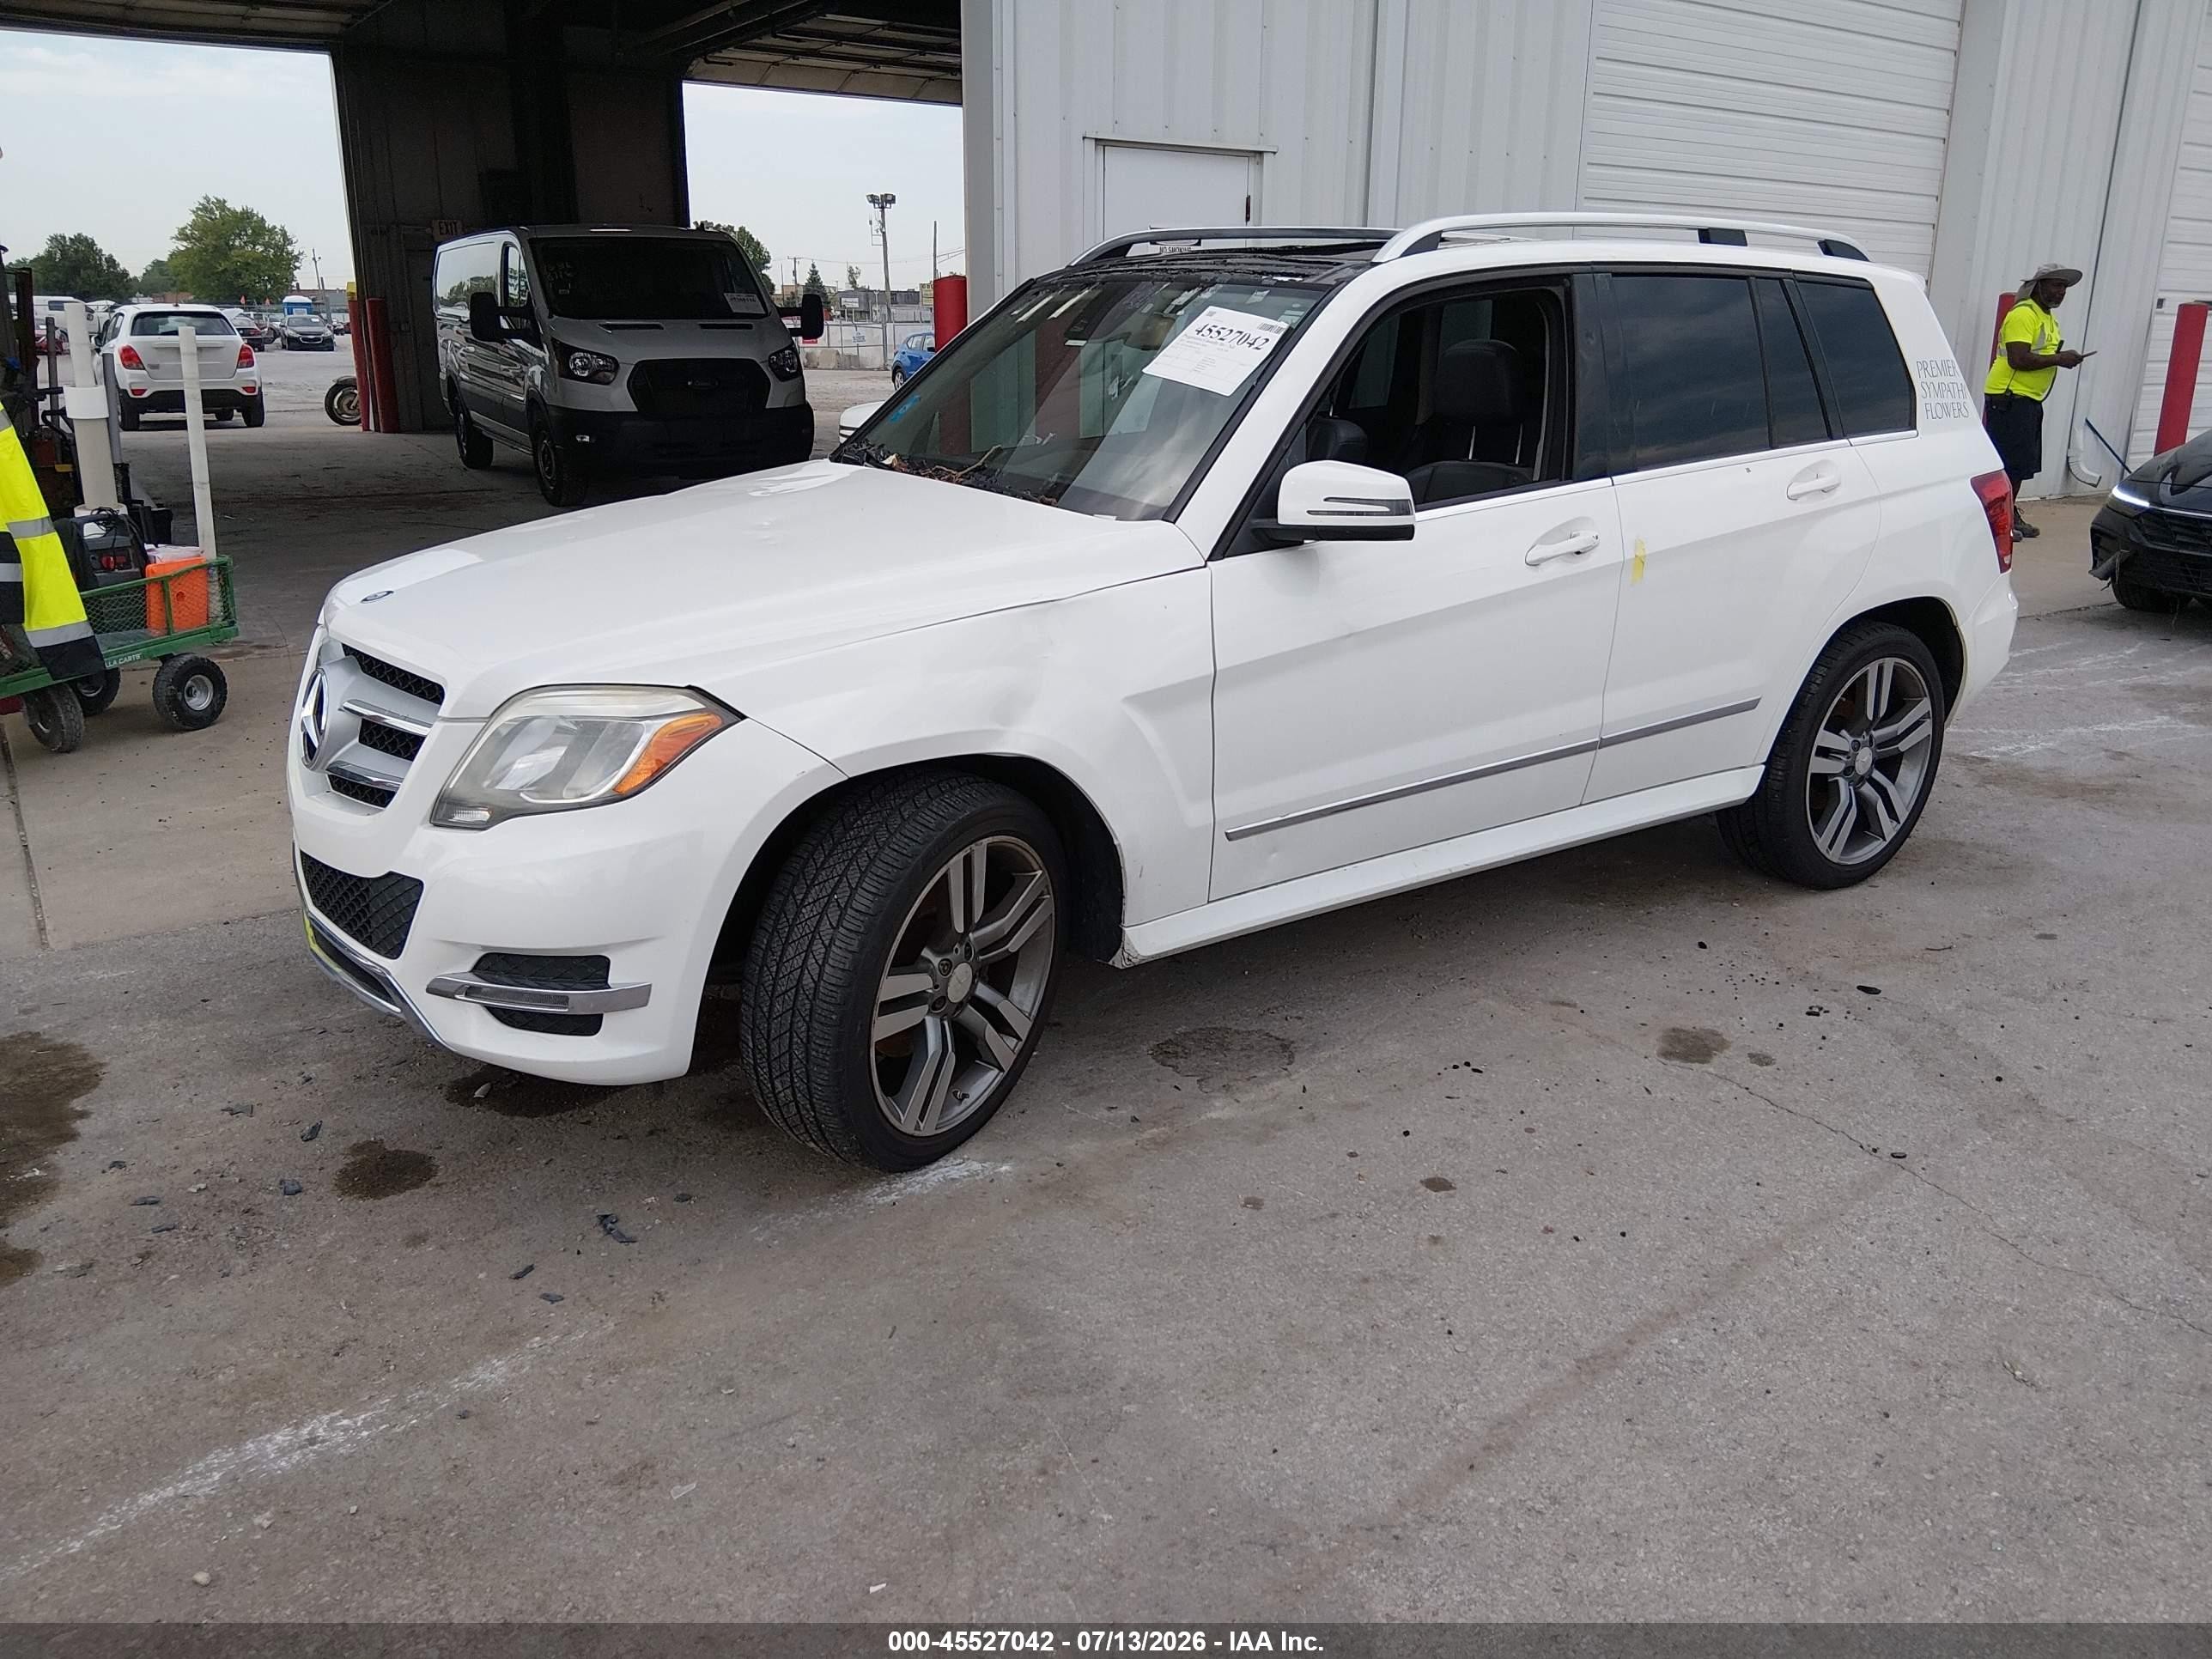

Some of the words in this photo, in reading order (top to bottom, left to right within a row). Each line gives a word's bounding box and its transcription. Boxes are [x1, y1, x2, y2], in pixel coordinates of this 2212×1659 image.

[439, 221, 457, 234] EXIT
[1194, 323, 1270, 350] 45527042
[1916, 359, 1960, 379] PREMIER
[1924, 401, 1969, 419] FLOWERS
